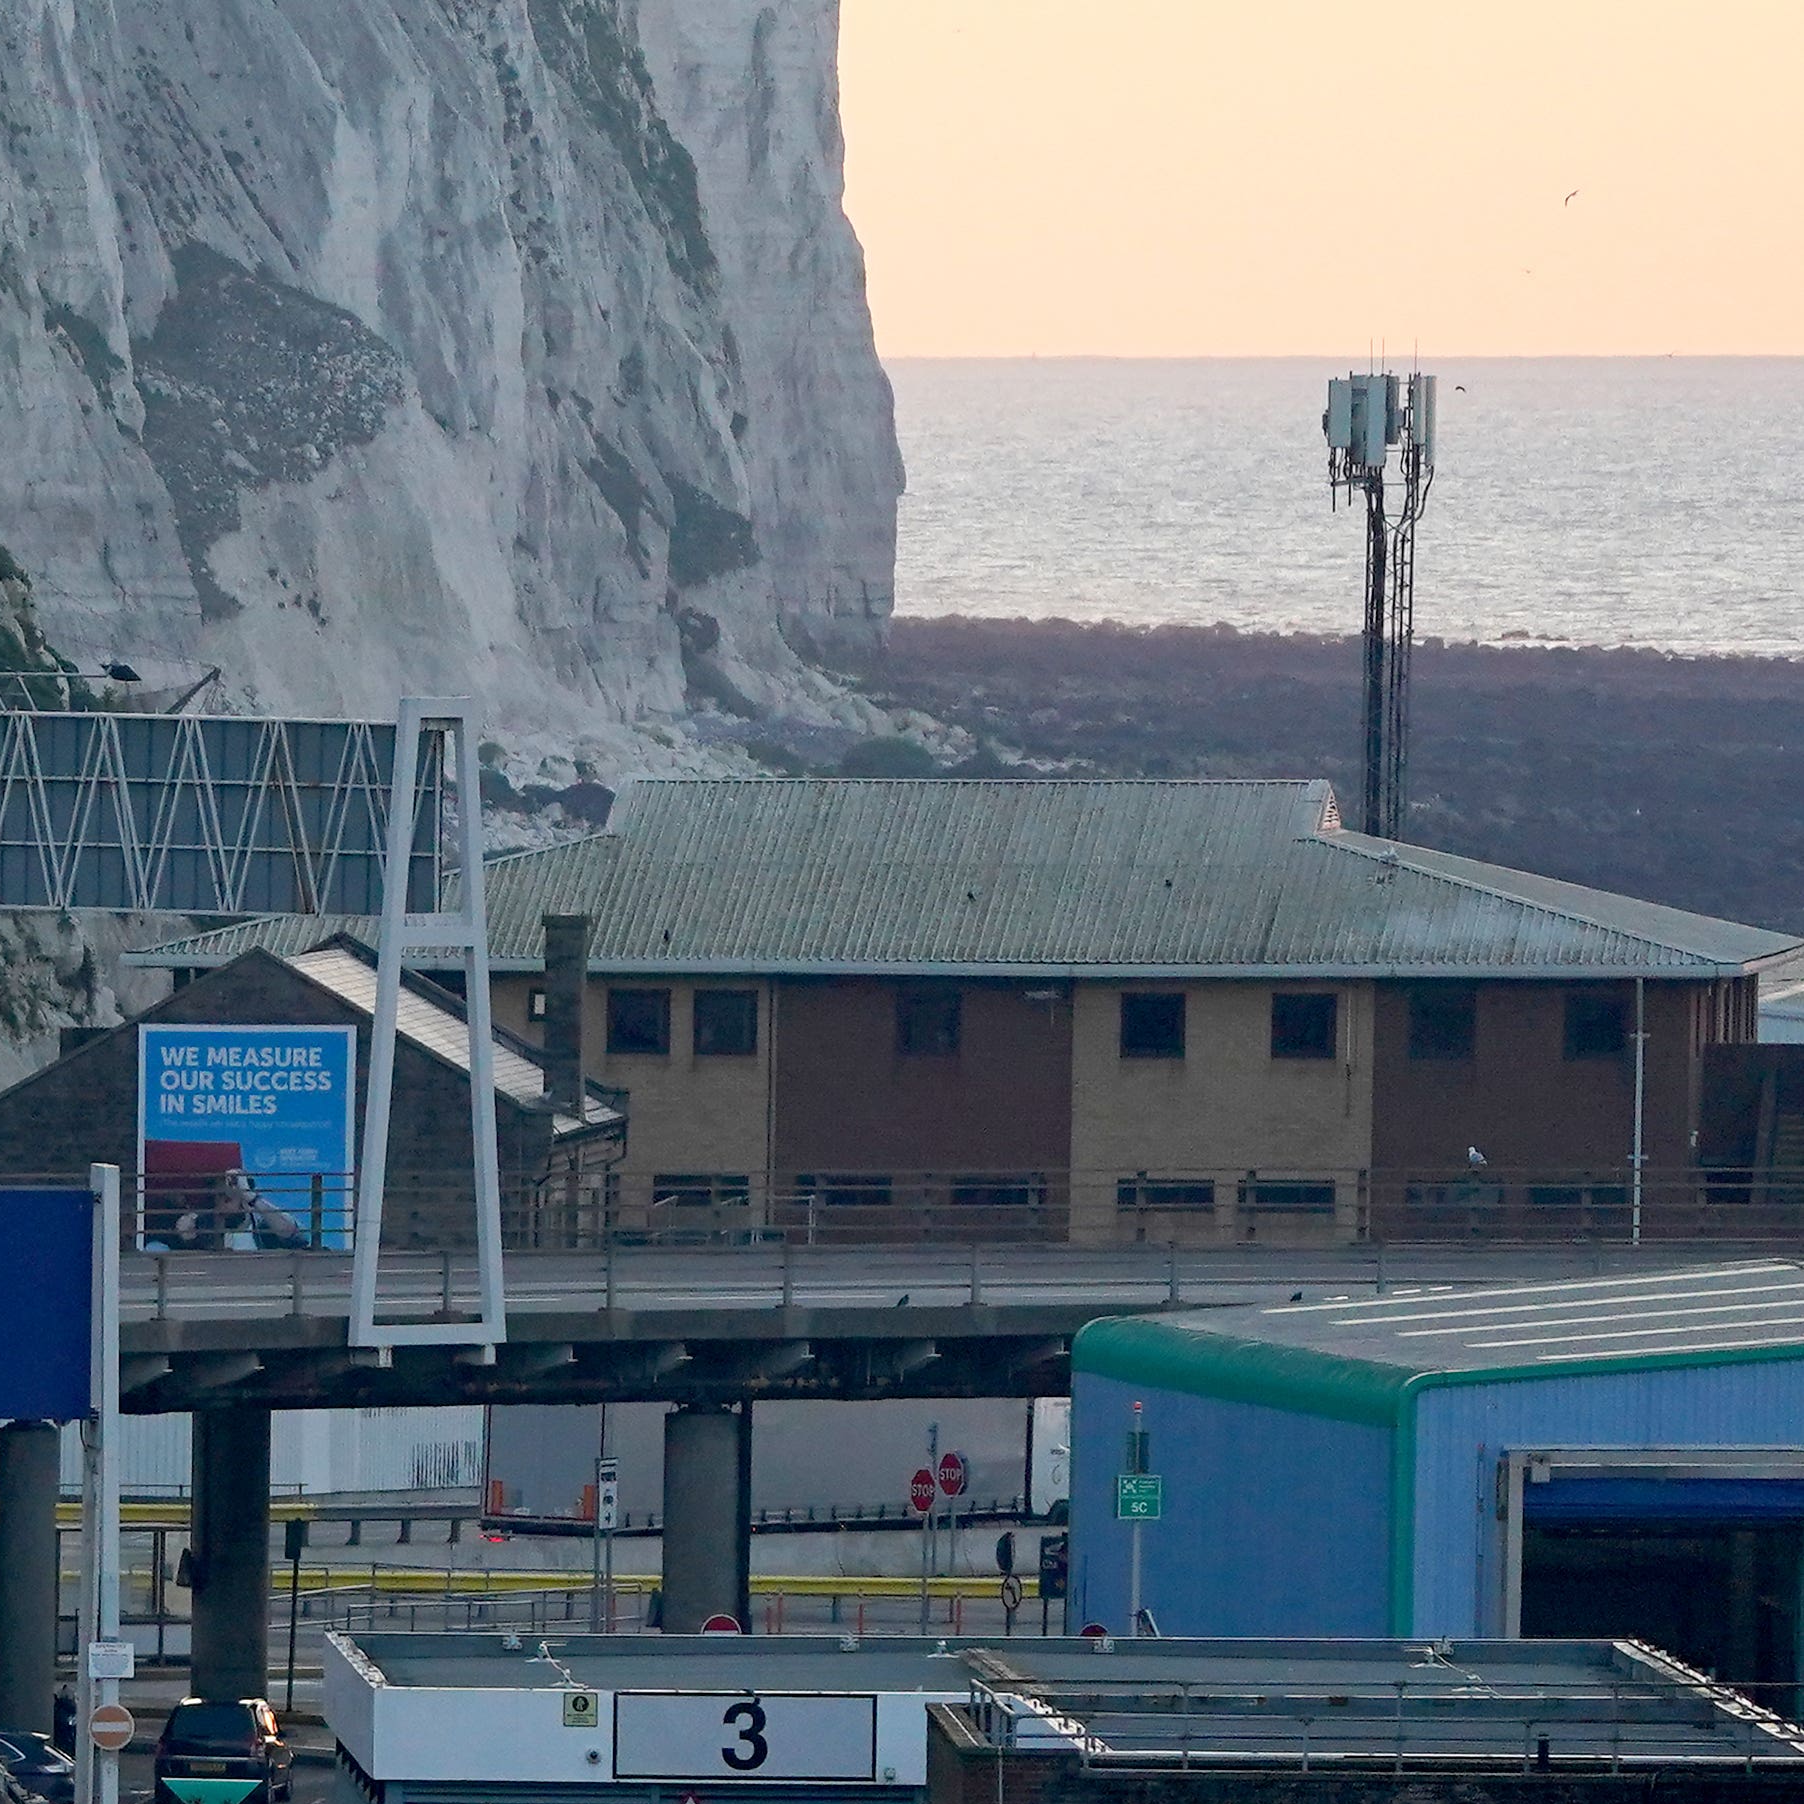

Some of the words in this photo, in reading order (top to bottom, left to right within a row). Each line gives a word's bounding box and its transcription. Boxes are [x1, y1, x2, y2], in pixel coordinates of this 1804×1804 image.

[160, 1046, 199, 1067] WE
[207, 1047, 323, 1067] MEASURE
[160, 1071, 214, 1091] OUR
[221, 1071, 332, 1091] SUCCESS
[160, 1094, 185, 1114] IN
[192, 1094, 278, 1115] SMILES
[939, 1468, 962, 1480] STOP
[912, 1484, 935, 1497] STOP
[721, 1702, 769, 1771] 3
